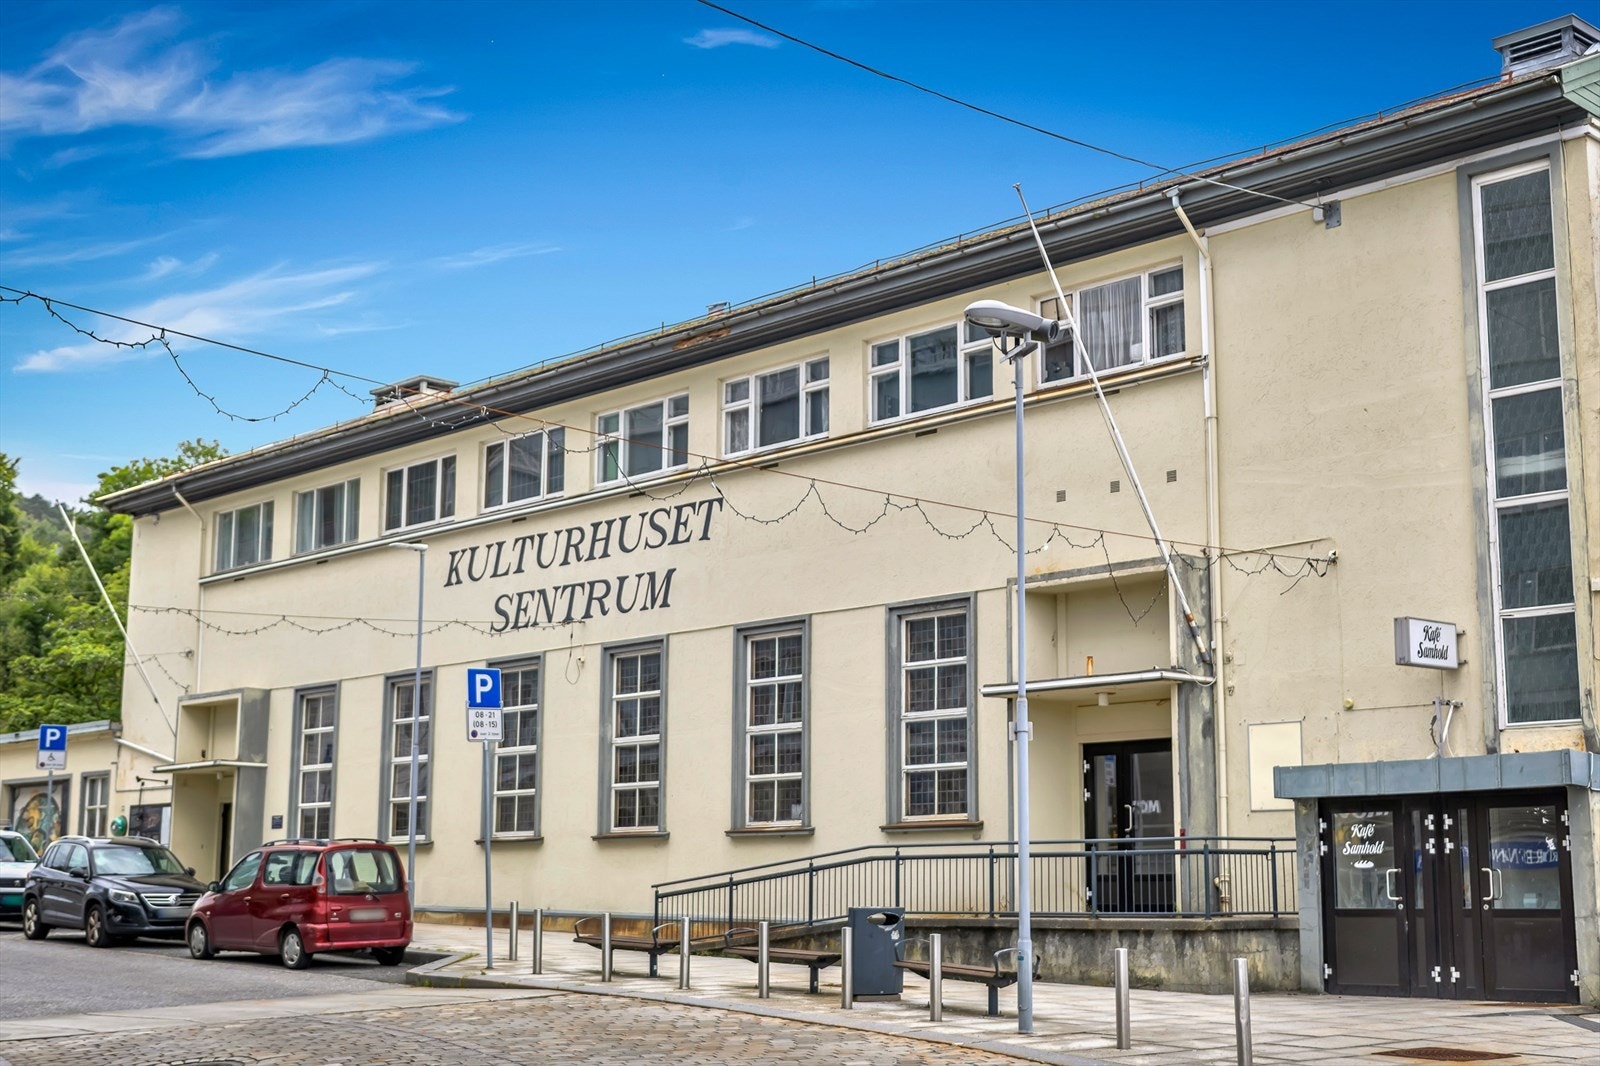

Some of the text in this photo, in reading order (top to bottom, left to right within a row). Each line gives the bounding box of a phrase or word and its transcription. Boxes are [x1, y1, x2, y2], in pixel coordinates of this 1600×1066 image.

[443, 497, 724, 587] KULTURHUSET
[489, 568, 677, 633] SENTRUM
[1423, 625, 1441, 644] Kafé
[1417, 642, 1449, 660] Samhold
[475, 673, 493, 703] P
[46, 728, 61, 748] P
[1351, 823, 1375, 839] Kafé
[1342, 841, 1385, 855] Samhold
